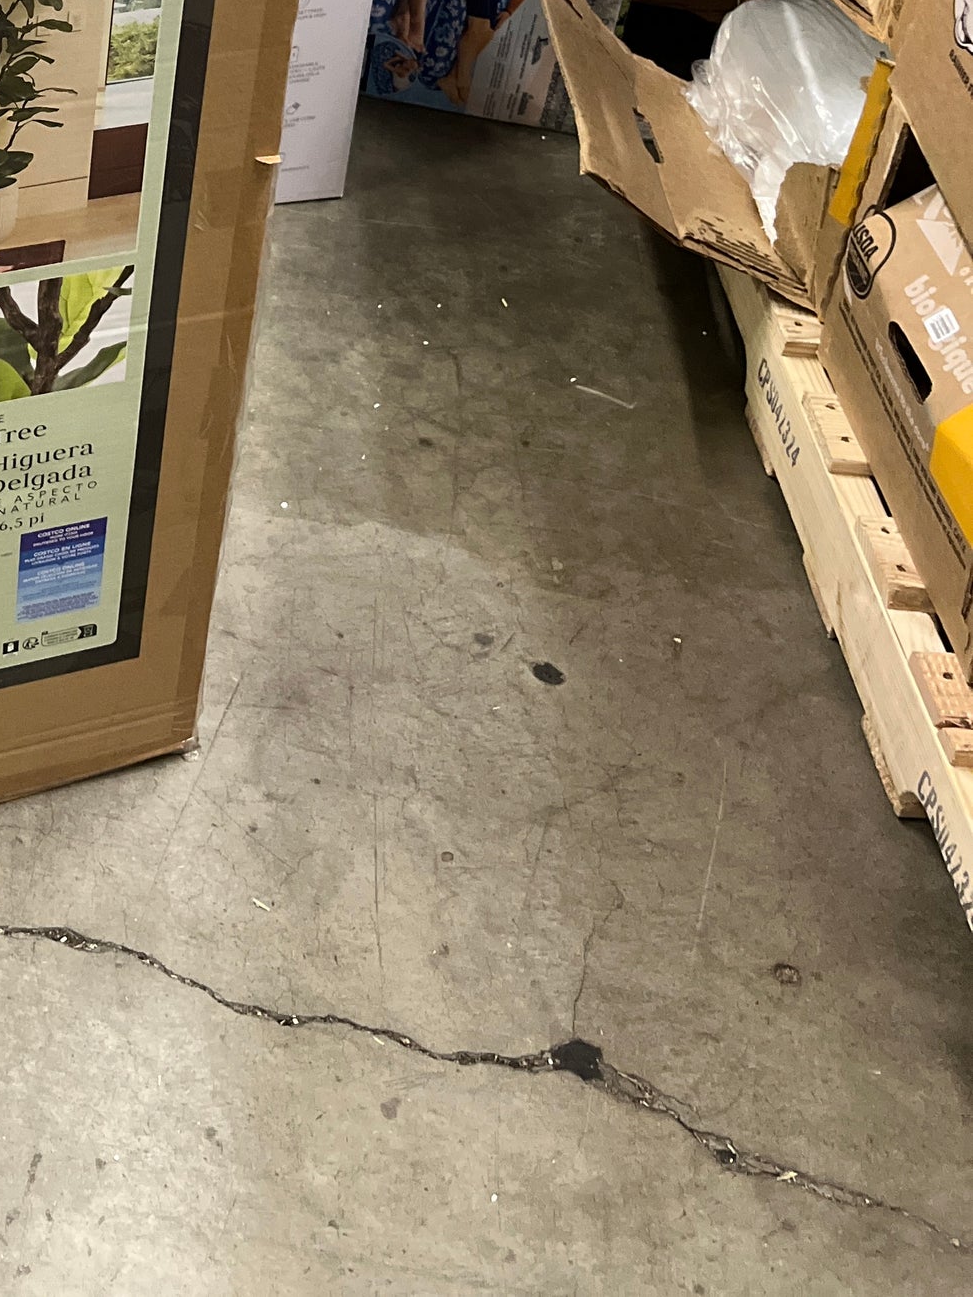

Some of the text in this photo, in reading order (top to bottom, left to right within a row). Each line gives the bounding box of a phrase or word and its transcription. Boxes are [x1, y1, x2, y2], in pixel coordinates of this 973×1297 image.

[903, 274, 973, 394] biolique
[14, 480, 98, 504] ASPECTO
[0, 517, 23, 532] 6,5
[28, 513, 45, 531] pi
[37, 523, 91, 538] COSTCO ONLINE
[33, 548, 60, 557] COSTCO
[72, 541, 91, 549] LIGNE
[916, 770, 973, 936] CPS04232
